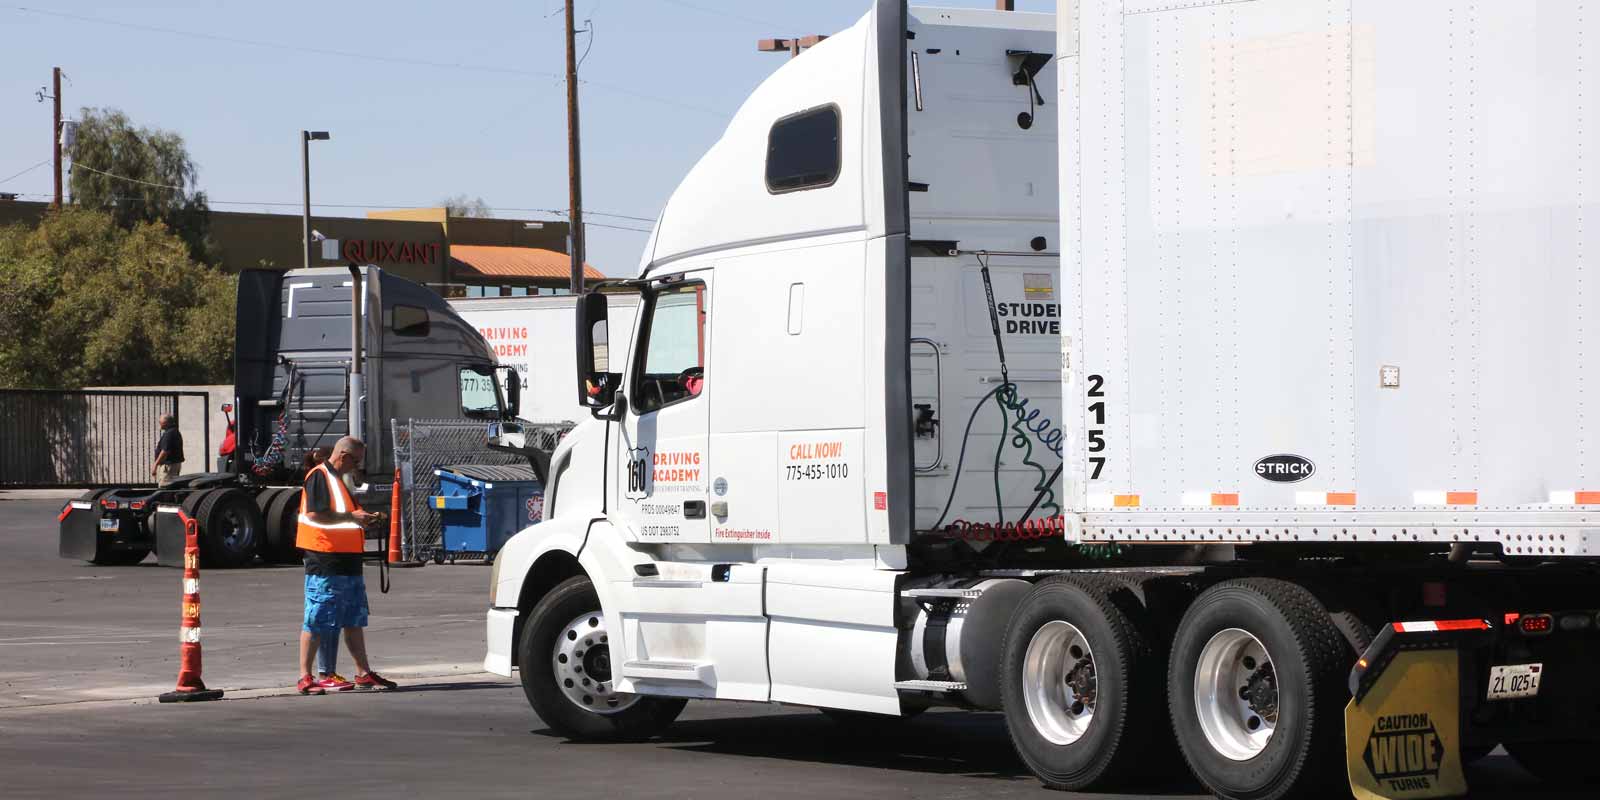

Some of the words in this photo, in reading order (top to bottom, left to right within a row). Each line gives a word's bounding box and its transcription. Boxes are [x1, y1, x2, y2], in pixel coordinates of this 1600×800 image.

[343, 239, 441, 265] QUIXANT
[479, 327, 528, 340] DRIVING
[1006, 320, 1060, 335] DRIVE
[1087, 374, 1106, 480] 2157
[653, 452, 700, 466] DRIVING
[790, 443, 813, 461] CALL
[814, 441, 843, 459] NOW!
[627, 459, 646, 493] 160
[652, 469, 700, 482] ACADEMY
[786, 463, 849, 481] 775-455-1010
[1256, 462, 1310, 474] STRICK
[641, 525, 648, 537] US
[648, 525, 658, 537] DOT
[715, 528, 725, 538] Fire
[725, 528, 756, 541] Extinguisher
[756, 529, 771, 540] Inside
[1378, 713, 1428, 730] CAUTION
[1370, 734, 1437, 774] WIDE
[1388, 776, 1431, 792] TURNS
